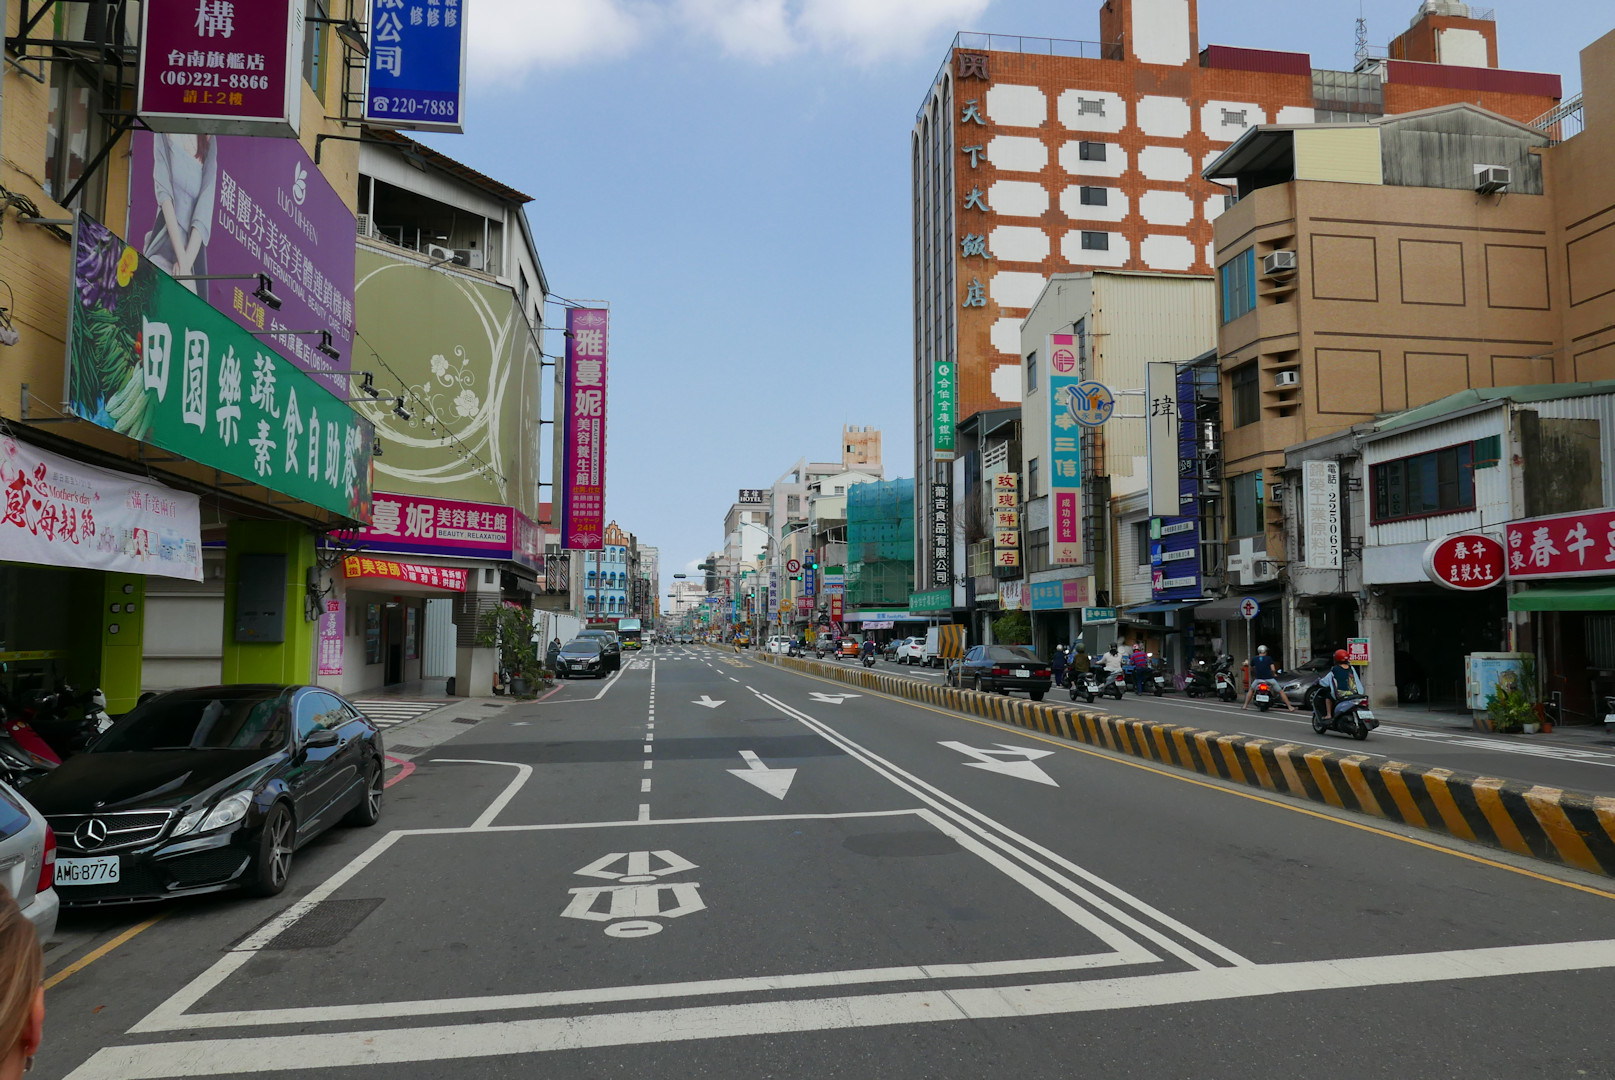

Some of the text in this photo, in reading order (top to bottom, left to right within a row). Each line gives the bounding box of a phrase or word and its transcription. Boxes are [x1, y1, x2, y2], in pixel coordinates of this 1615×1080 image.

[194, 0, 235, 38] 構
[168, 49, 265, 70] 台南旗艦店
[160, 70, 269, 90] (06)221-8866
[183, 89, 243, 105] 請上2樓
[392, 97, 454, 116] 220-7888
[278, 187, 294, 218] LUO
[961, 99, 992, 308] 天下大飯店
[219, 209, 235, 235] LUO
[235, 226, 248, 247] LIH
[248, 237, 261, 260] FEN
[263, 252, 306, 303] INTERNATIONAL
[308, 294, 327, 320] BEAUTY
[220, 169, 352, 328] 羅麗芬美容美體連鎖機構
[233, 286, 265, 330] 請上2樓
[575, 329, 603, 416] 雅蔓妮
[576, 418, 591, 486] 美容養生館
[437, 507, 507, 531] 美容養生館
[935, 486, 948, 583] 葡吉食品有限公司
[998, 475, 1016, 565] 玫瑰鮮花店
[1061, 498, 1072, 538] 成功分社
[467, 532, 506, 541] RELAXATION
[1454, 541, 1487, 559] 春牛
[1508, 529, 1526, 570] 台東
[361, 558, 401, 577] 美容師
[1450, 564, 1493, 582] 豆漿大王
[56, 862, 118, 881] AMG-8776
